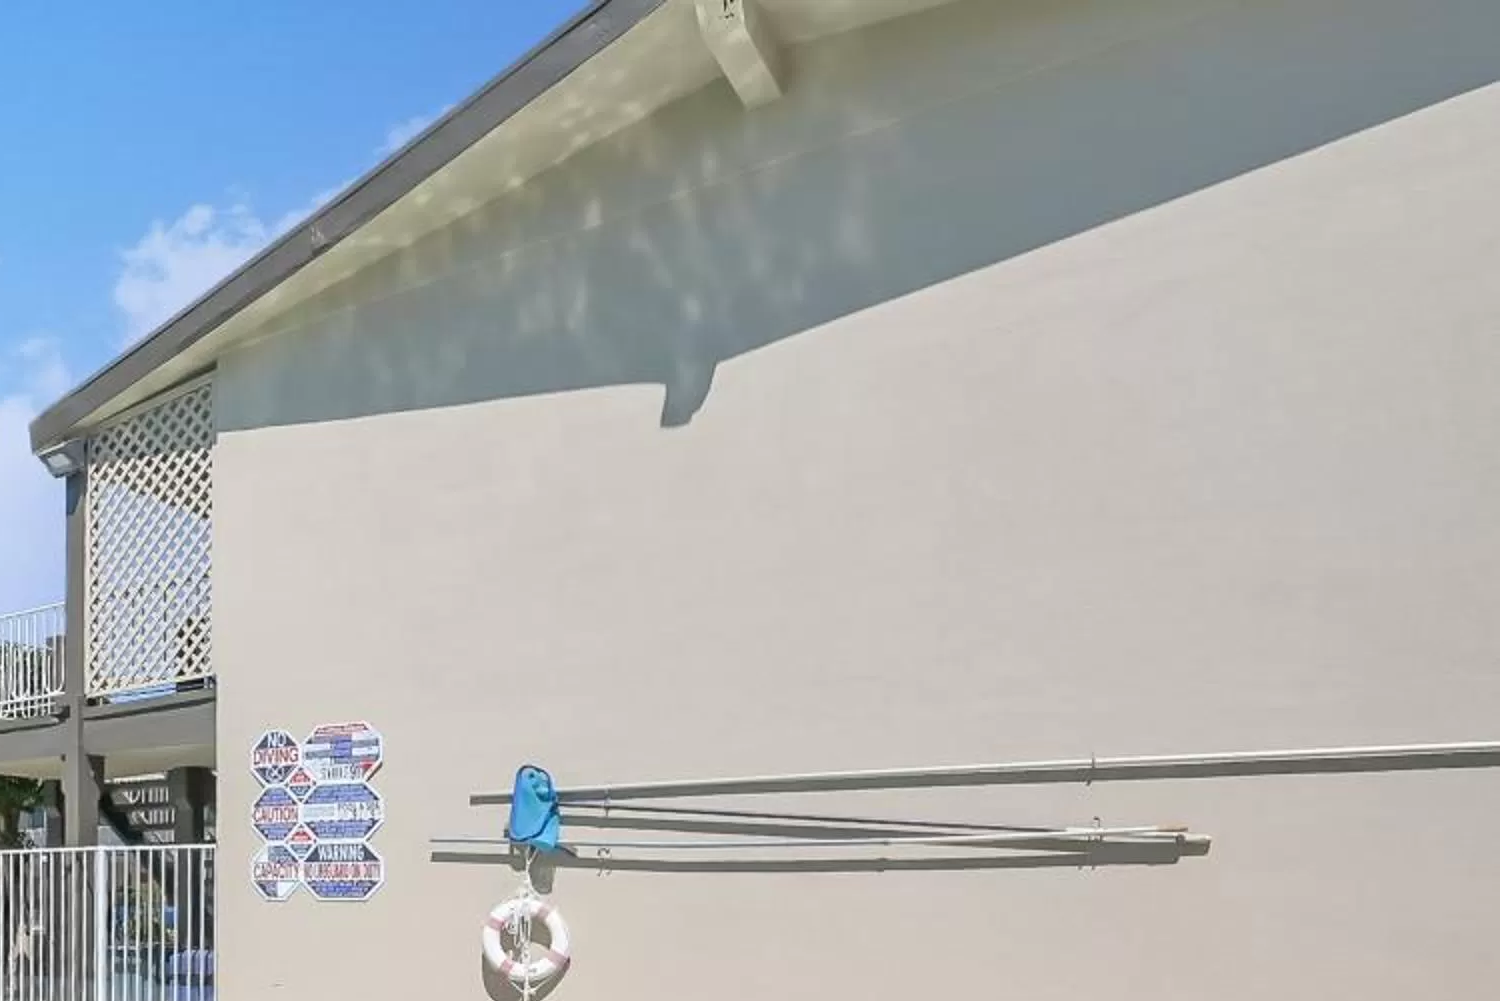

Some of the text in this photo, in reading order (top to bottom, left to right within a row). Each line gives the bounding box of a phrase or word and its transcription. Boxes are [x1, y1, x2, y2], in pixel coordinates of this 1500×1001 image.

[267, 731, 286, 747] NO
[253, 747, 299, 766] DIVING
[253, 805, 298, 823] CAUTION
[317, 844, 365, 861] WARNING
[253, 861, 299, 879] CAPACITY
